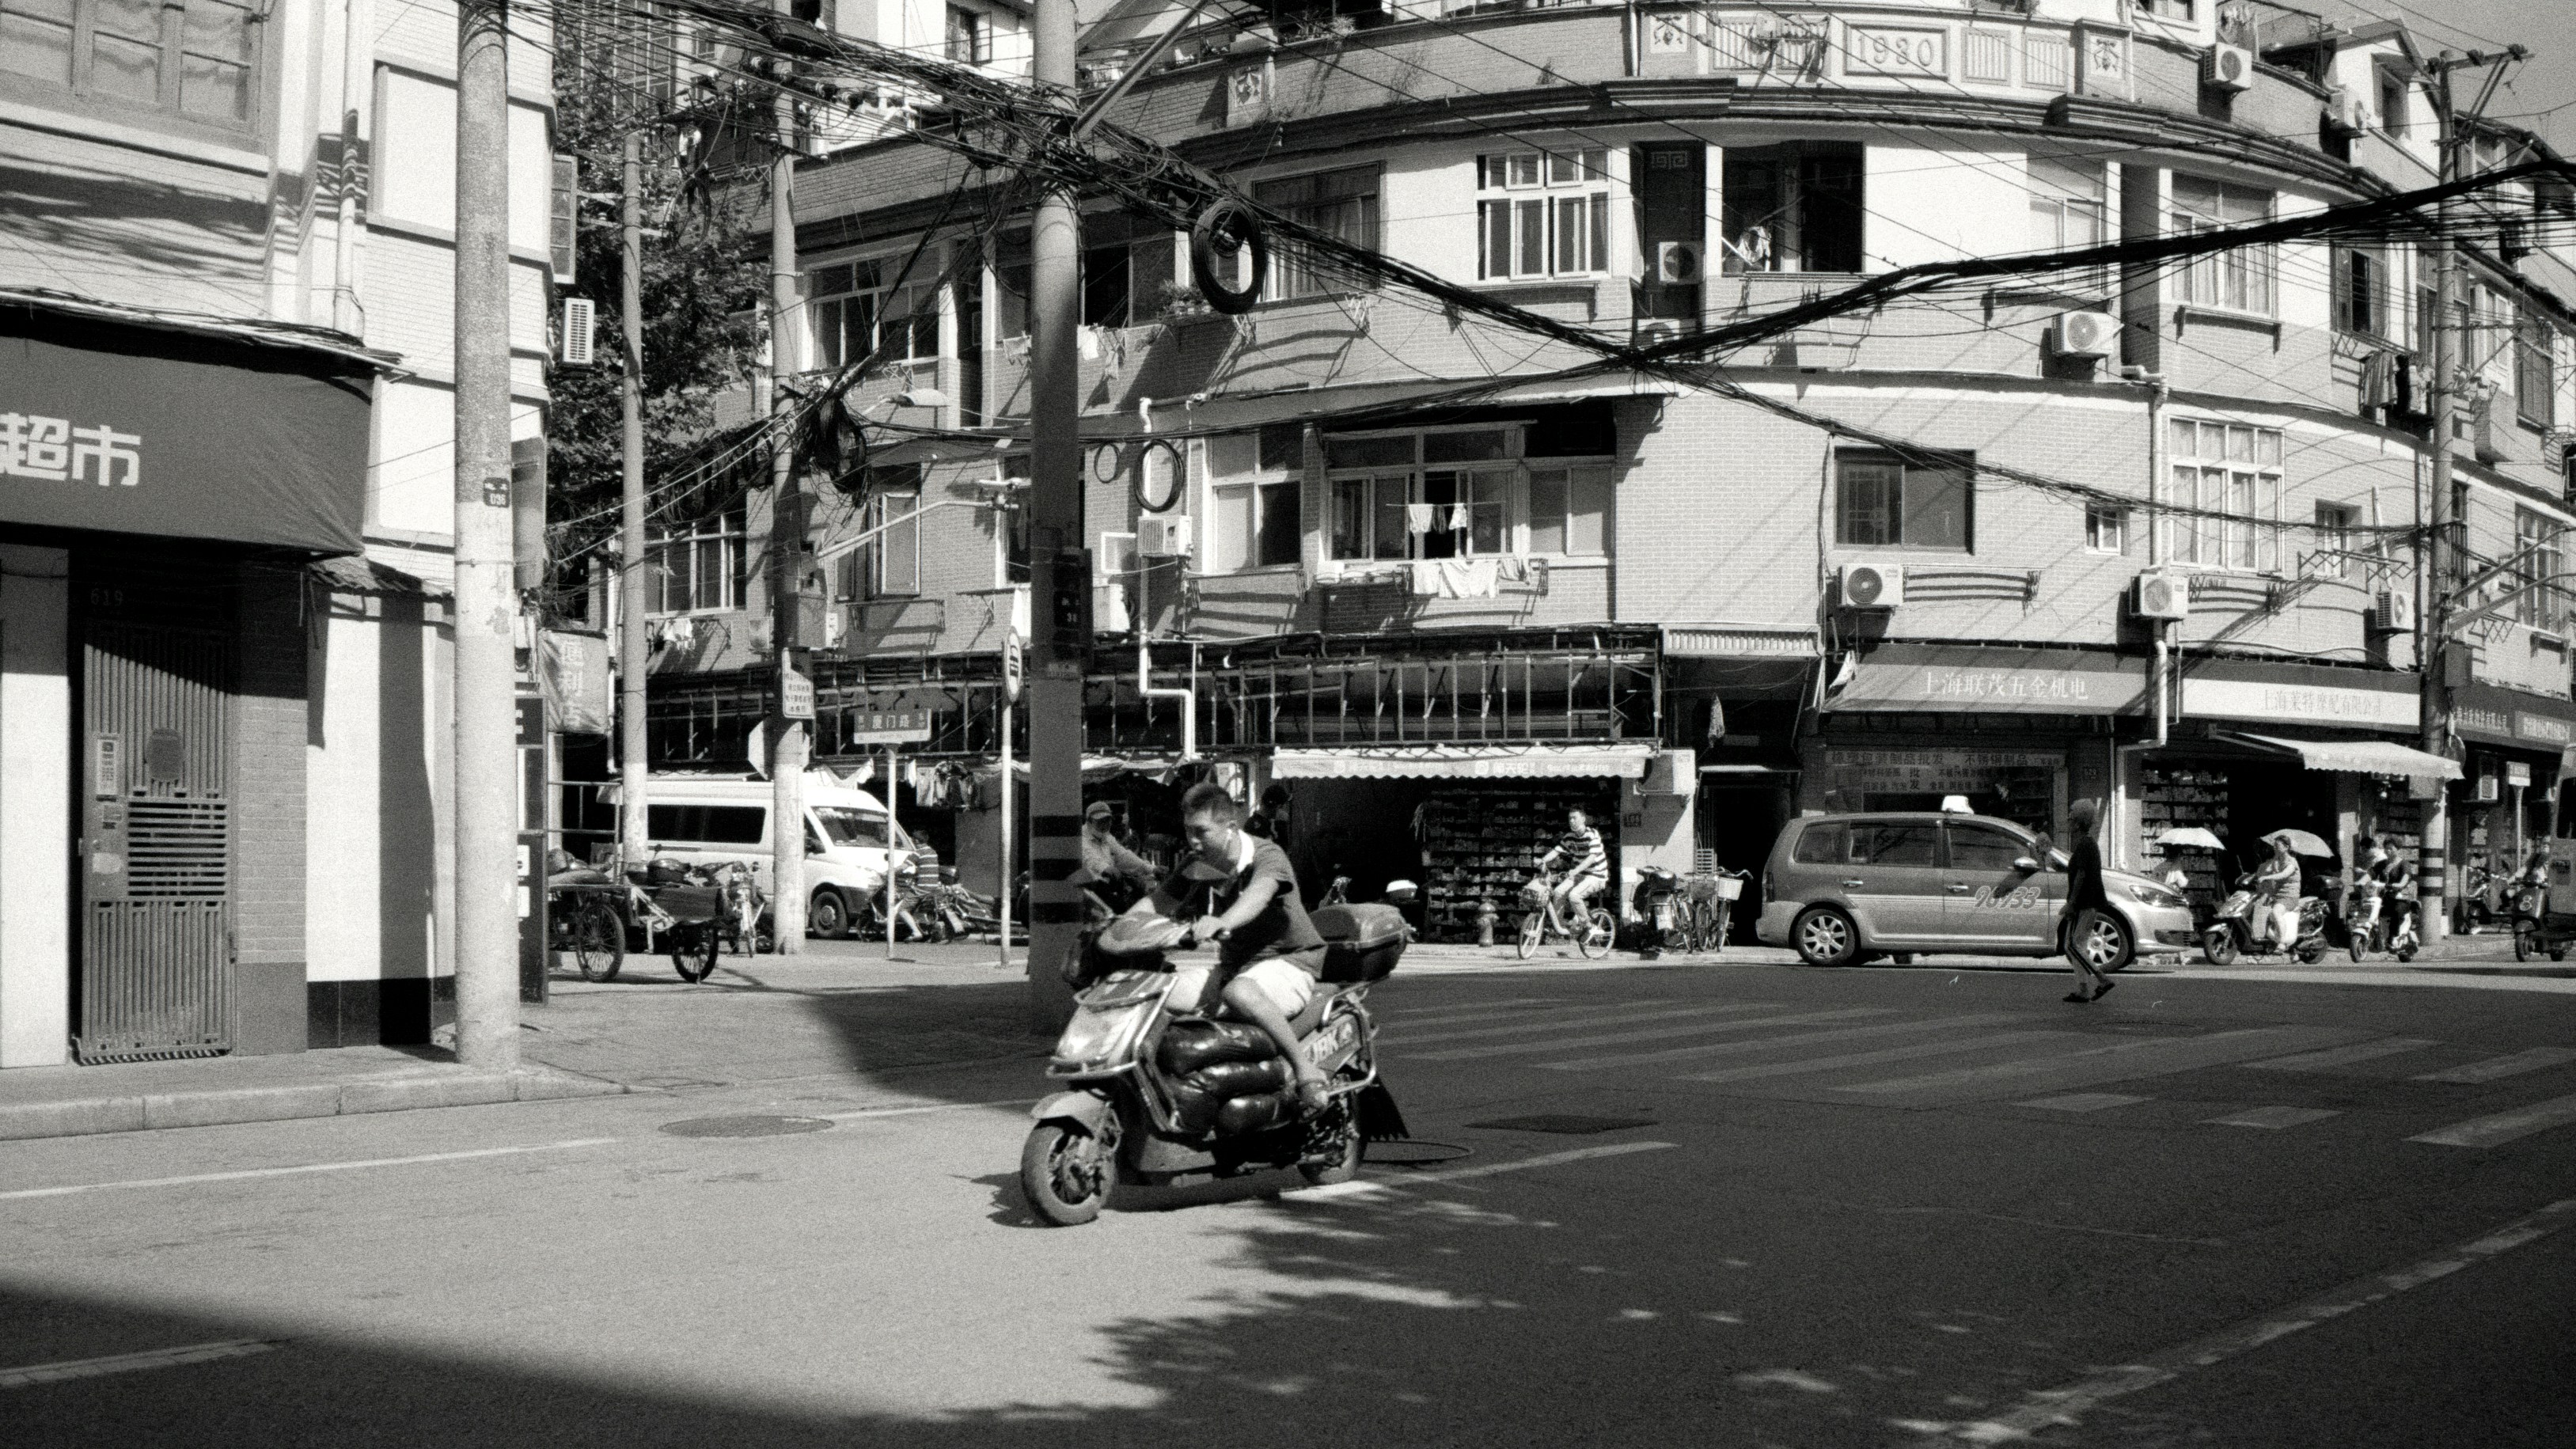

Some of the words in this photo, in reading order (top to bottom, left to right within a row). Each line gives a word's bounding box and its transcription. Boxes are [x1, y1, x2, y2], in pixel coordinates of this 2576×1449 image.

[1857, 35, 1934, 67] 1930
[0, 412, 142, 487] 超市
[89, 587, 124, 607] 619
[1918, 671, 2089, 700] 上海联茂五金机电
[2518, 895, 2533, 912] 8
